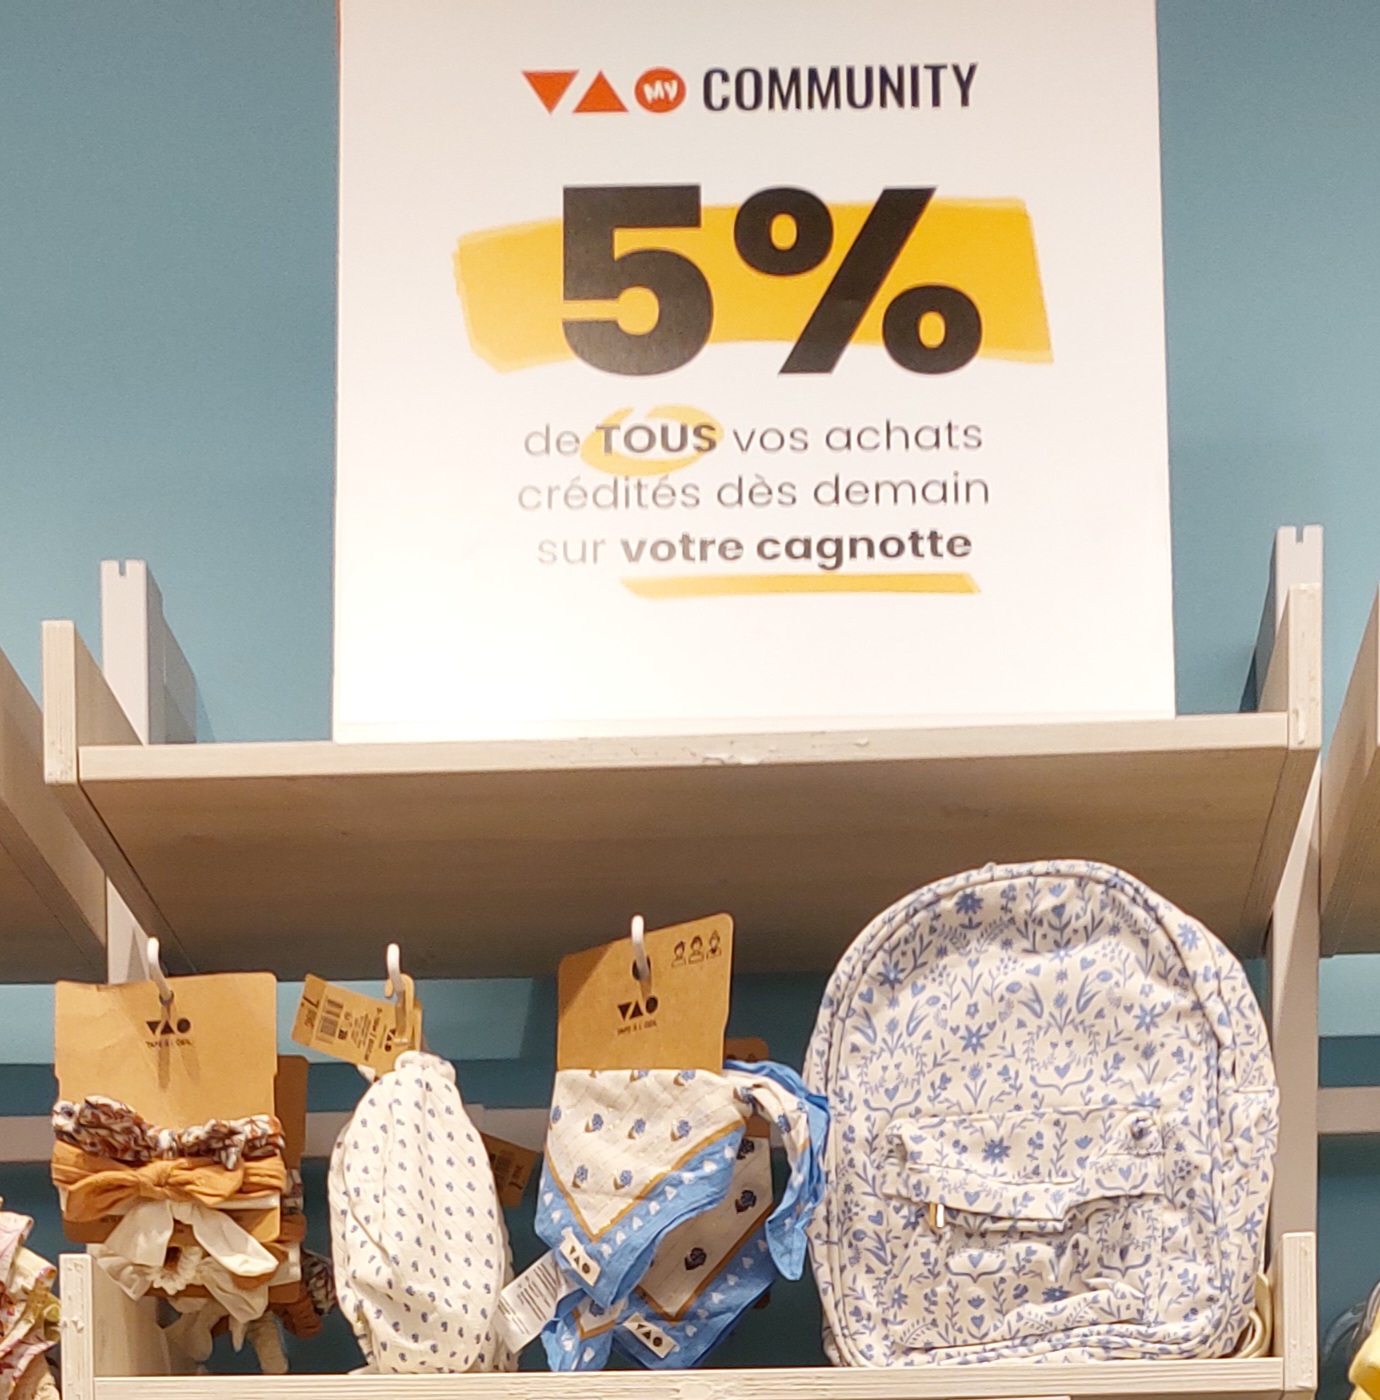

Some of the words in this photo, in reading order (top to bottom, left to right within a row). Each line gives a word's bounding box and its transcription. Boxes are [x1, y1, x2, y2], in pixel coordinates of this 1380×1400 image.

[643, 79, 679, 104] MY
[703, 63, 978, 112] COMMUNITY
[562, 184, 982, 376] 5%
[524, 423, 581, 456] de
[595, 422, 718, 454] TOUS
[732, 427, 809, 453] vos
[825, 418, 983, 452] achats
[518, 475, 701, 510] crédités
[716, 473, 797, 509] dès
[813, 470, 989, 507] demain
[537, 538, 606, 565] sur
[620, 531, 744, 564] votre
[756, 529, 972, 572] cagnotte
